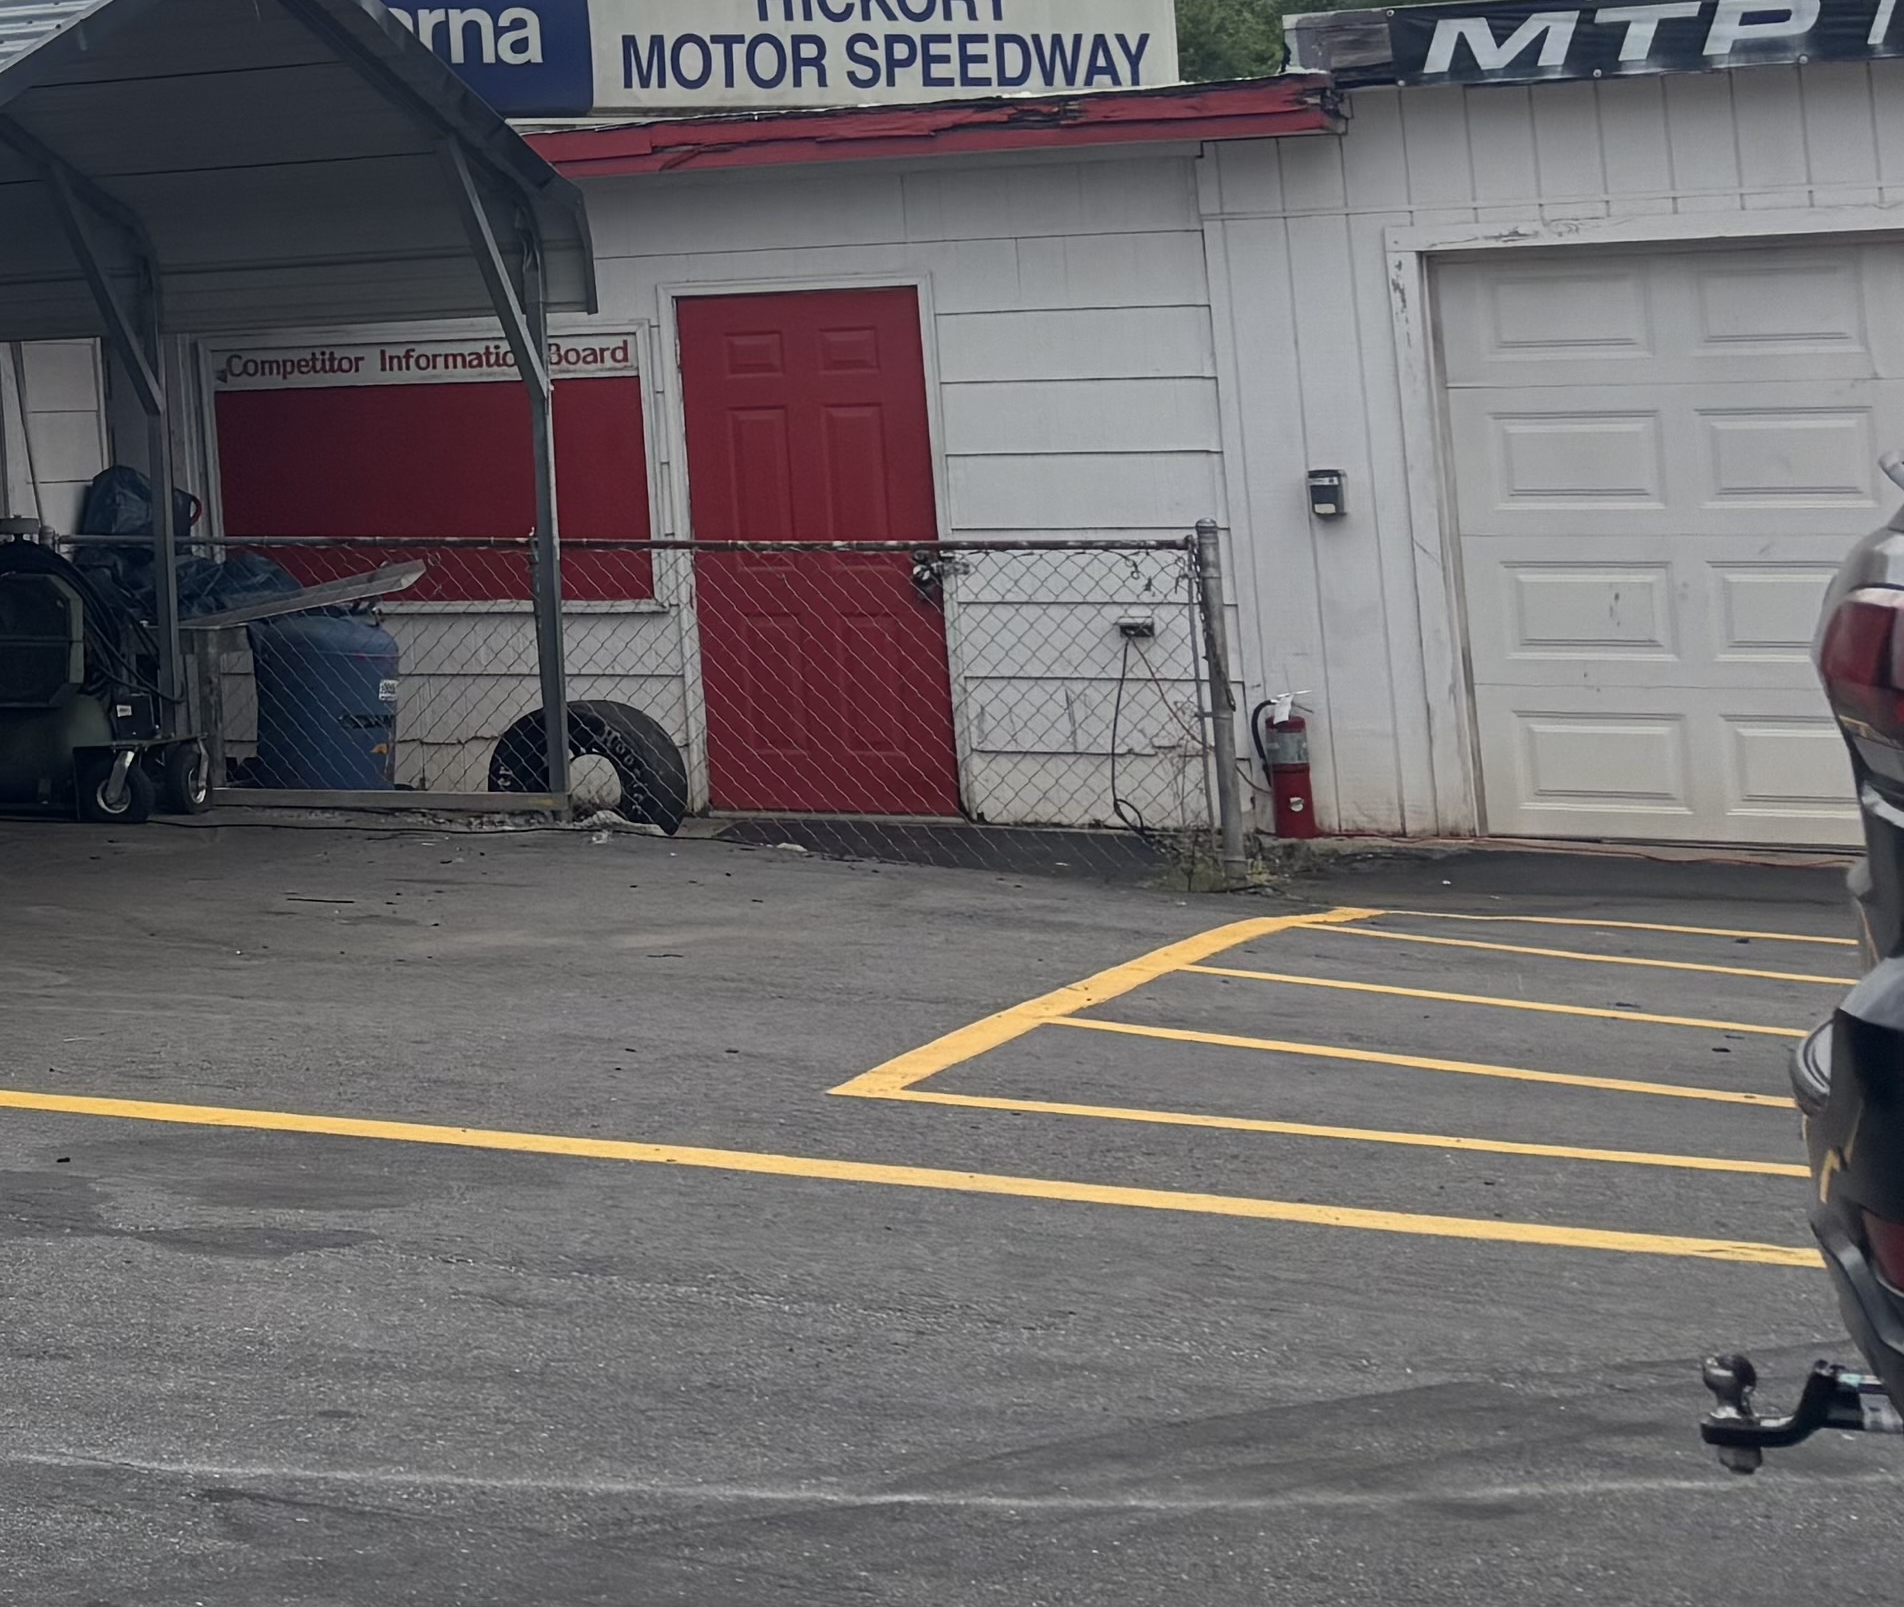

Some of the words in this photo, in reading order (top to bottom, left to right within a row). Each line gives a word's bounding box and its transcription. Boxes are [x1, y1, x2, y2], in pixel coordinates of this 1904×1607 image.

[621, 33, 830, 90] MOTOR
[845, 31, 1151, 90] SPEEDWAY
[227, 352, 365, 380] Competitor
[380, 343, 519, 372] Informatio
[547, 339, 630, 366] Board
